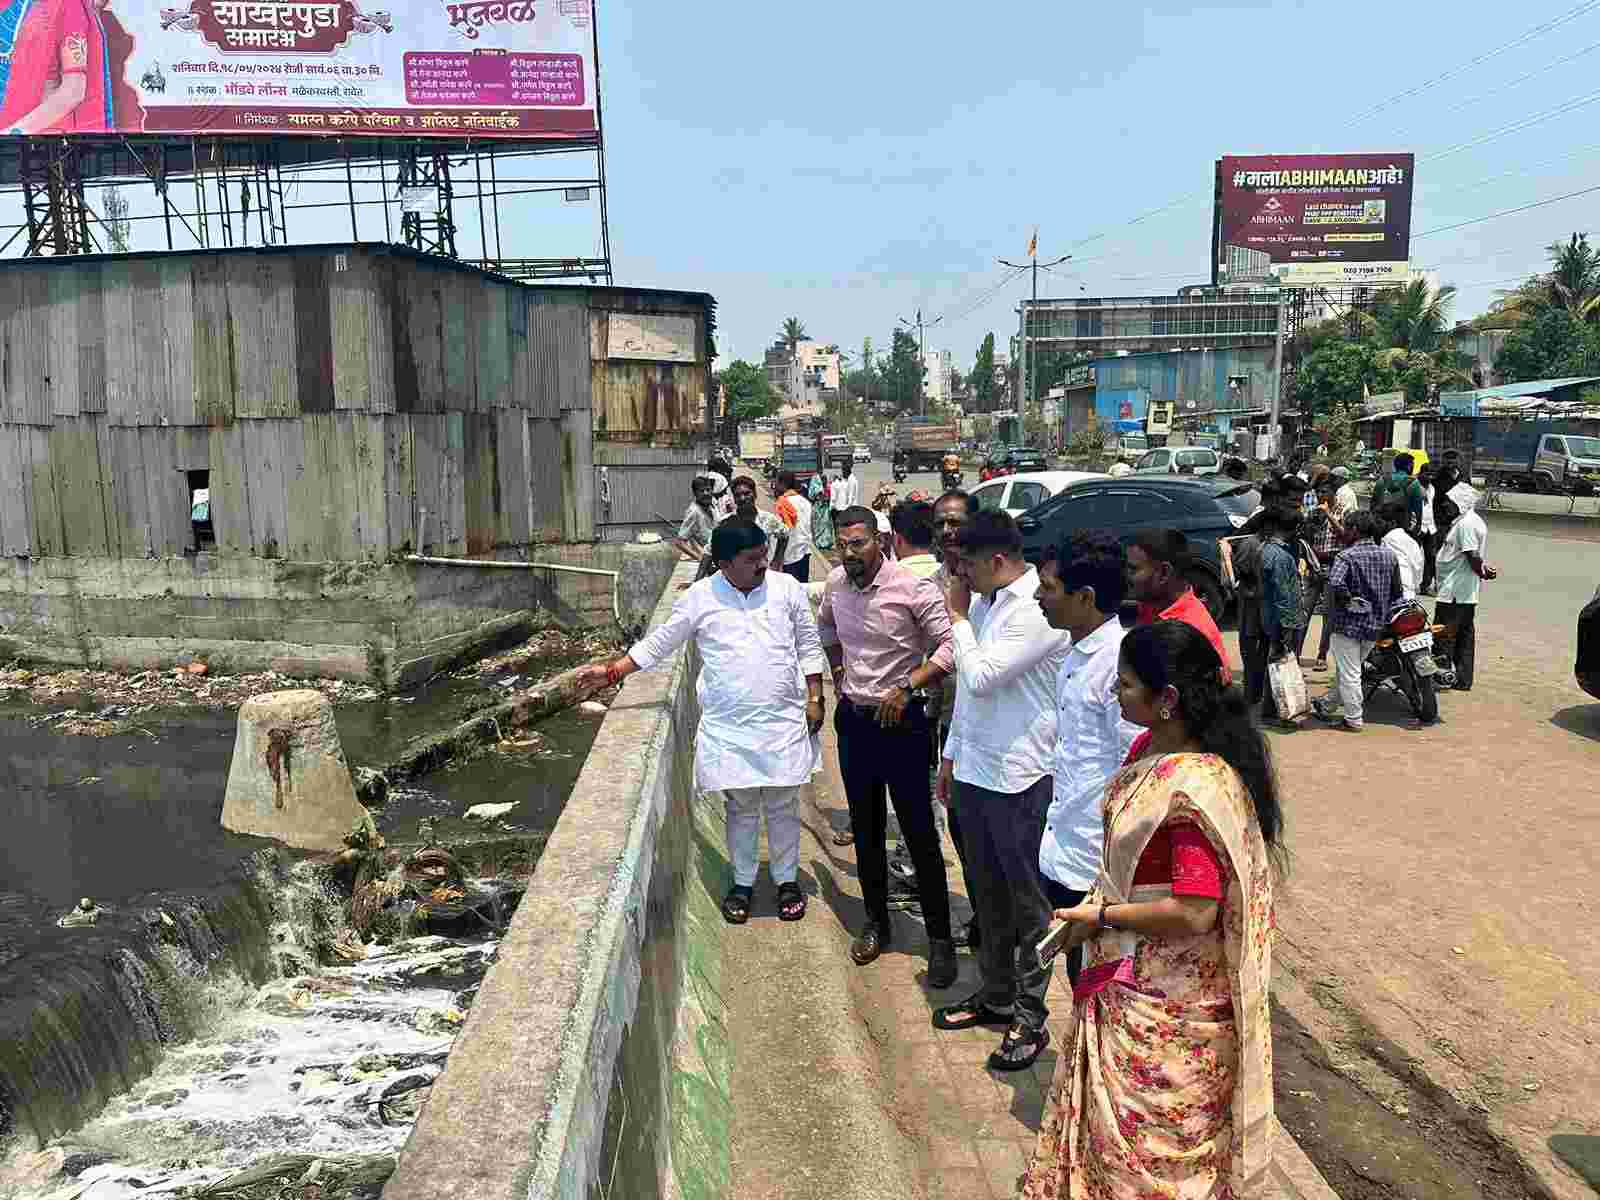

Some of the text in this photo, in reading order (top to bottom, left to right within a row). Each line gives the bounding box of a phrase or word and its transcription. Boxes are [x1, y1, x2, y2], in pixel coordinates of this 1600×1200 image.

[210, 1, 341, 38] साखरपुडा
[223, 25, 297, 48] समारंभ
[1249, 215, 1296, 225] ABHIMAAN
